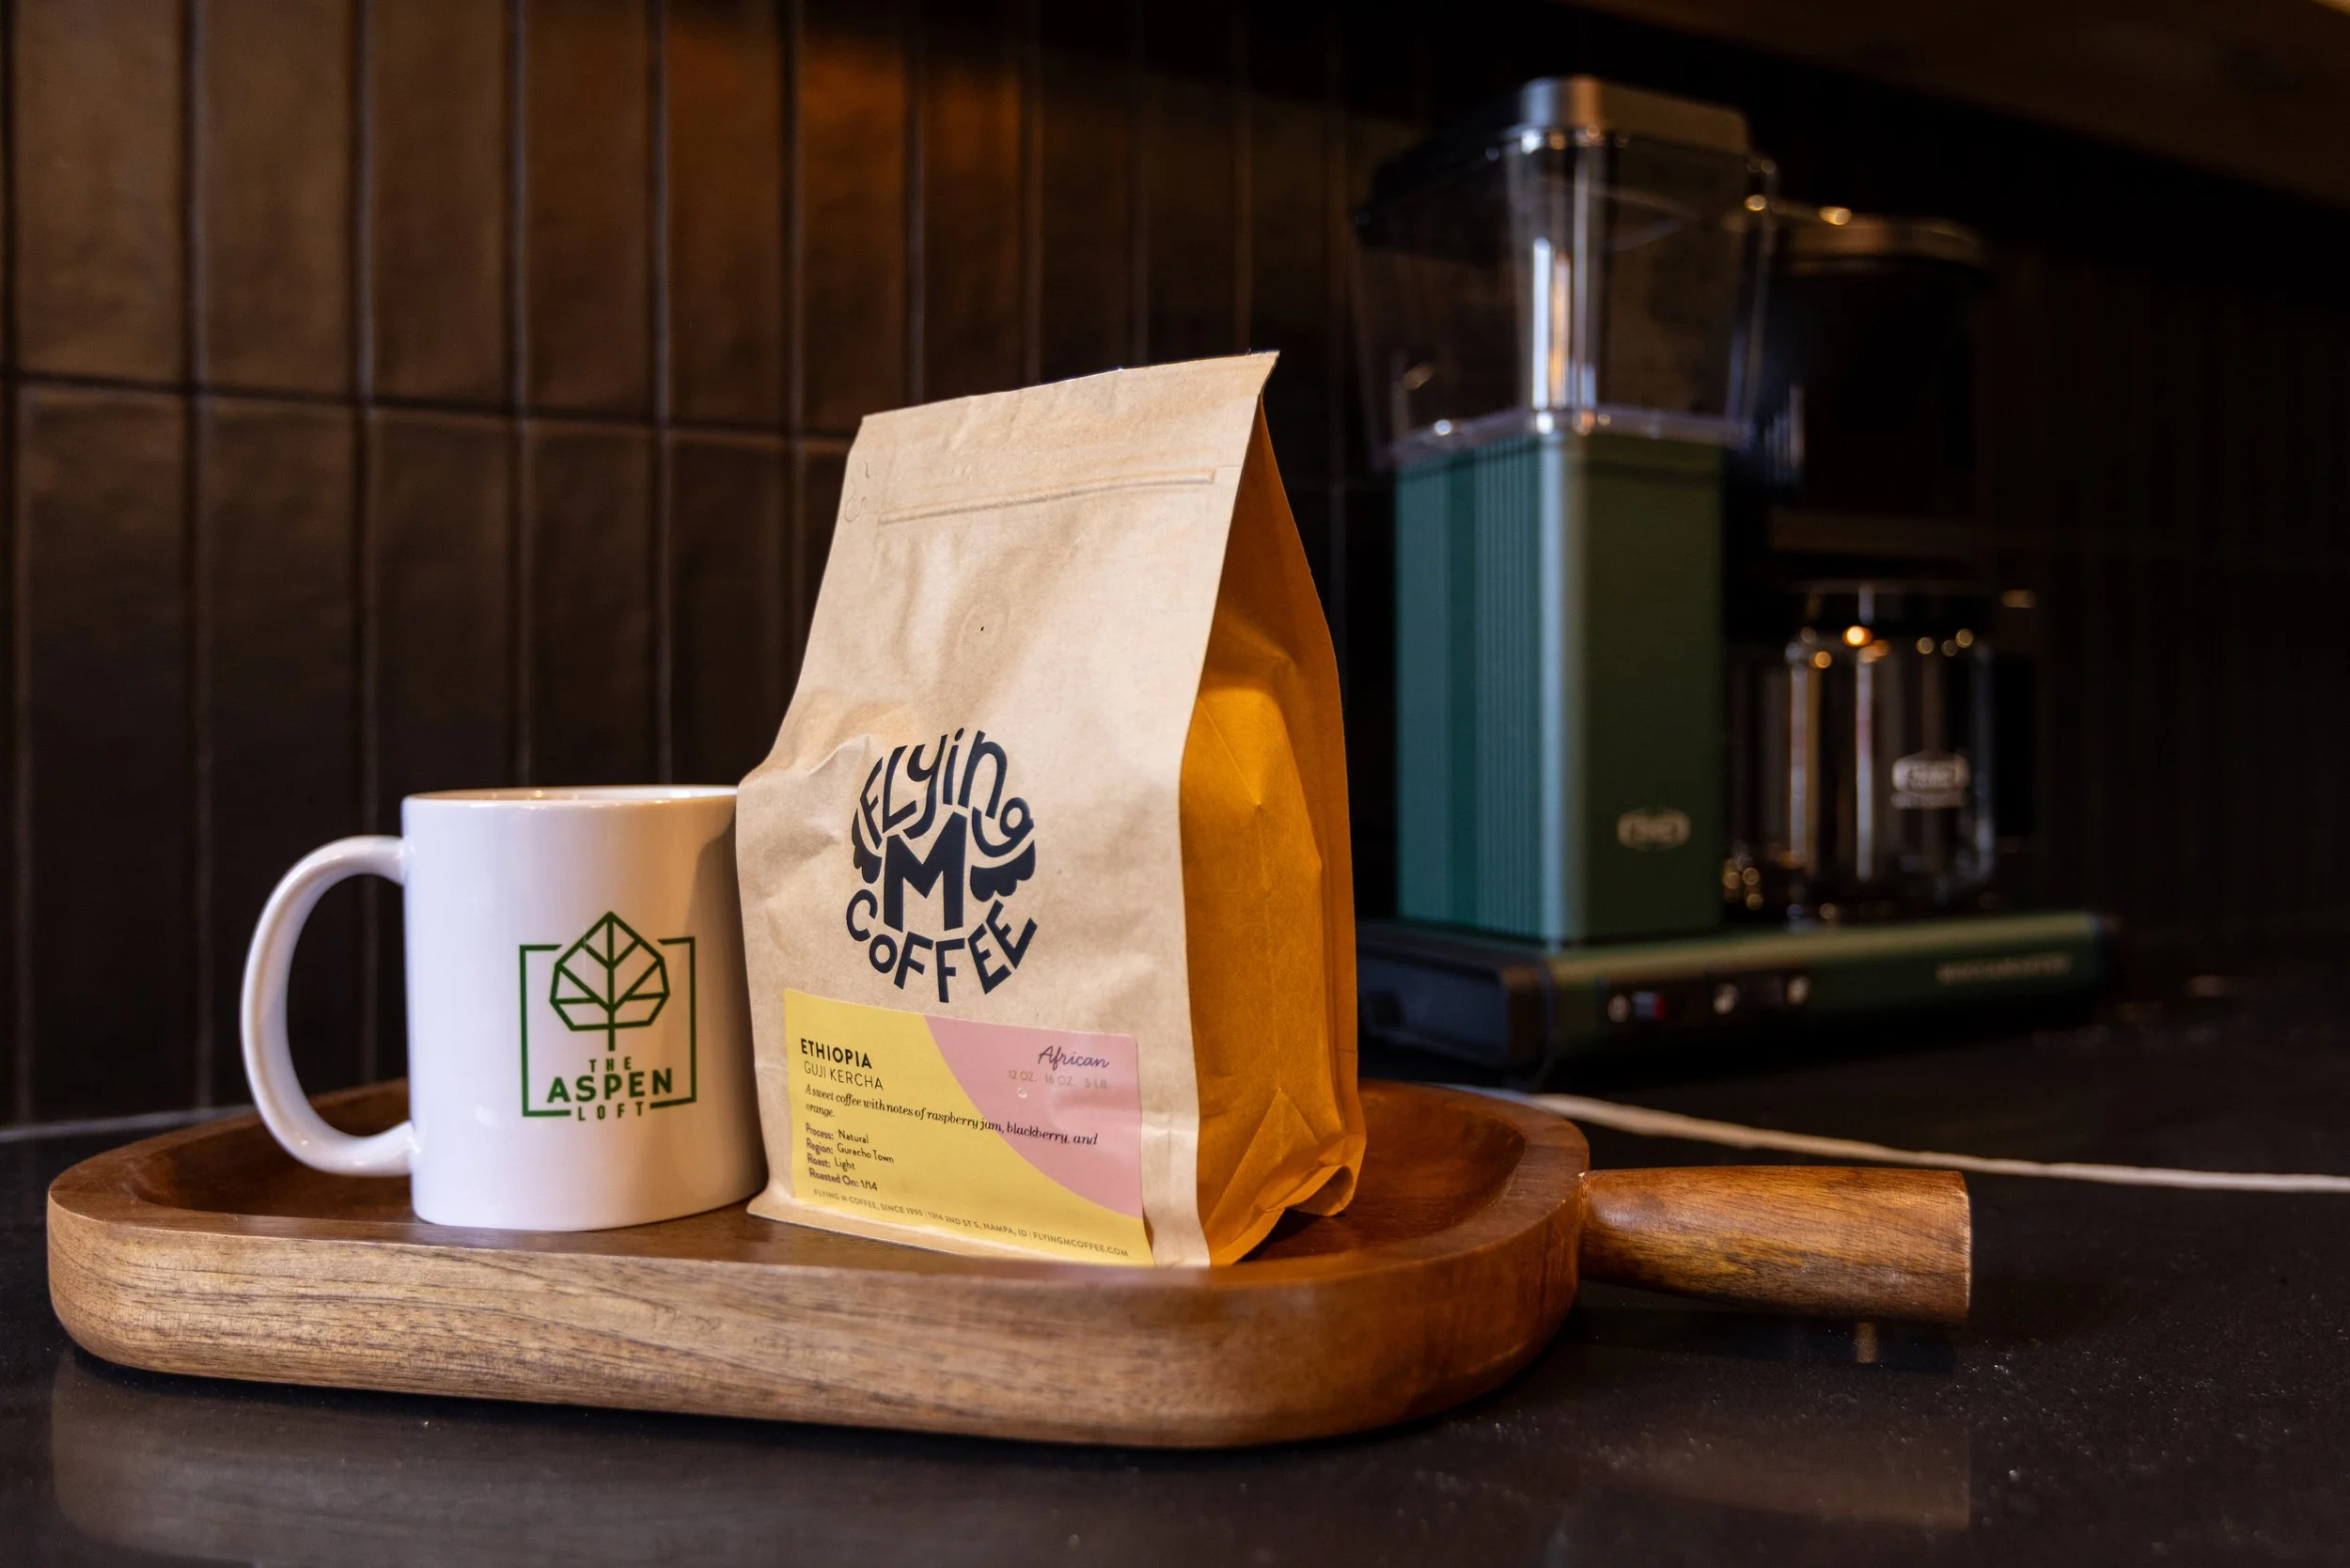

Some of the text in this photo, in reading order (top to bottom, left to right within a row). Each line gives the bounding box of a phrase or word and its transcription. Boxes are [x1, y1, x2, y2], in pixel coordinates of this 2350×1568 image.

[884, 811, 967, 933] M
[846, 888, 1038, 1003] COFFEE
[588, 1057, 632, 1073] THE
[801, 1038, 872, 1069] ETHIOPIA
[1038, 1045, 1110, 1071] African
[546, 1067, 672, 1103] ASPEN
[804, 1060, 884, 1090] GUJI KERCHA
[1009, 1070, 1017, 1080] 12
[1045, 1074, 1055, 1085] 16
[578, 1102, 644, 1121] LOFT
[806, 1104, 835, 1118] orange.
[806, 1084, 1098, 1145] A sweet coffee with notes of raspberry jam, blackberry, and
[805, 1121, 870, 1144] Process: Natural
[806, 1137, 895, 1164] Region: Guracho Town
[807, 1152, 855, 1172] Roast: Light
[809, 1168, 878, 1191] Roasted On: 1/14
[813, 1188, 840, 1200] FLYING
[849, 1196, 880, 1211] COFFEE,
[880, 1202, 904, 1214] SINCE
[945, 1215, 961, 1226] 2ND
[983, 1223, 1016, 1236] NAMPA,
[1018, 1229, 1027, 1237] ID
[1033, 1231, 1129, 1257] FLYINGMCOFFEE.COM
